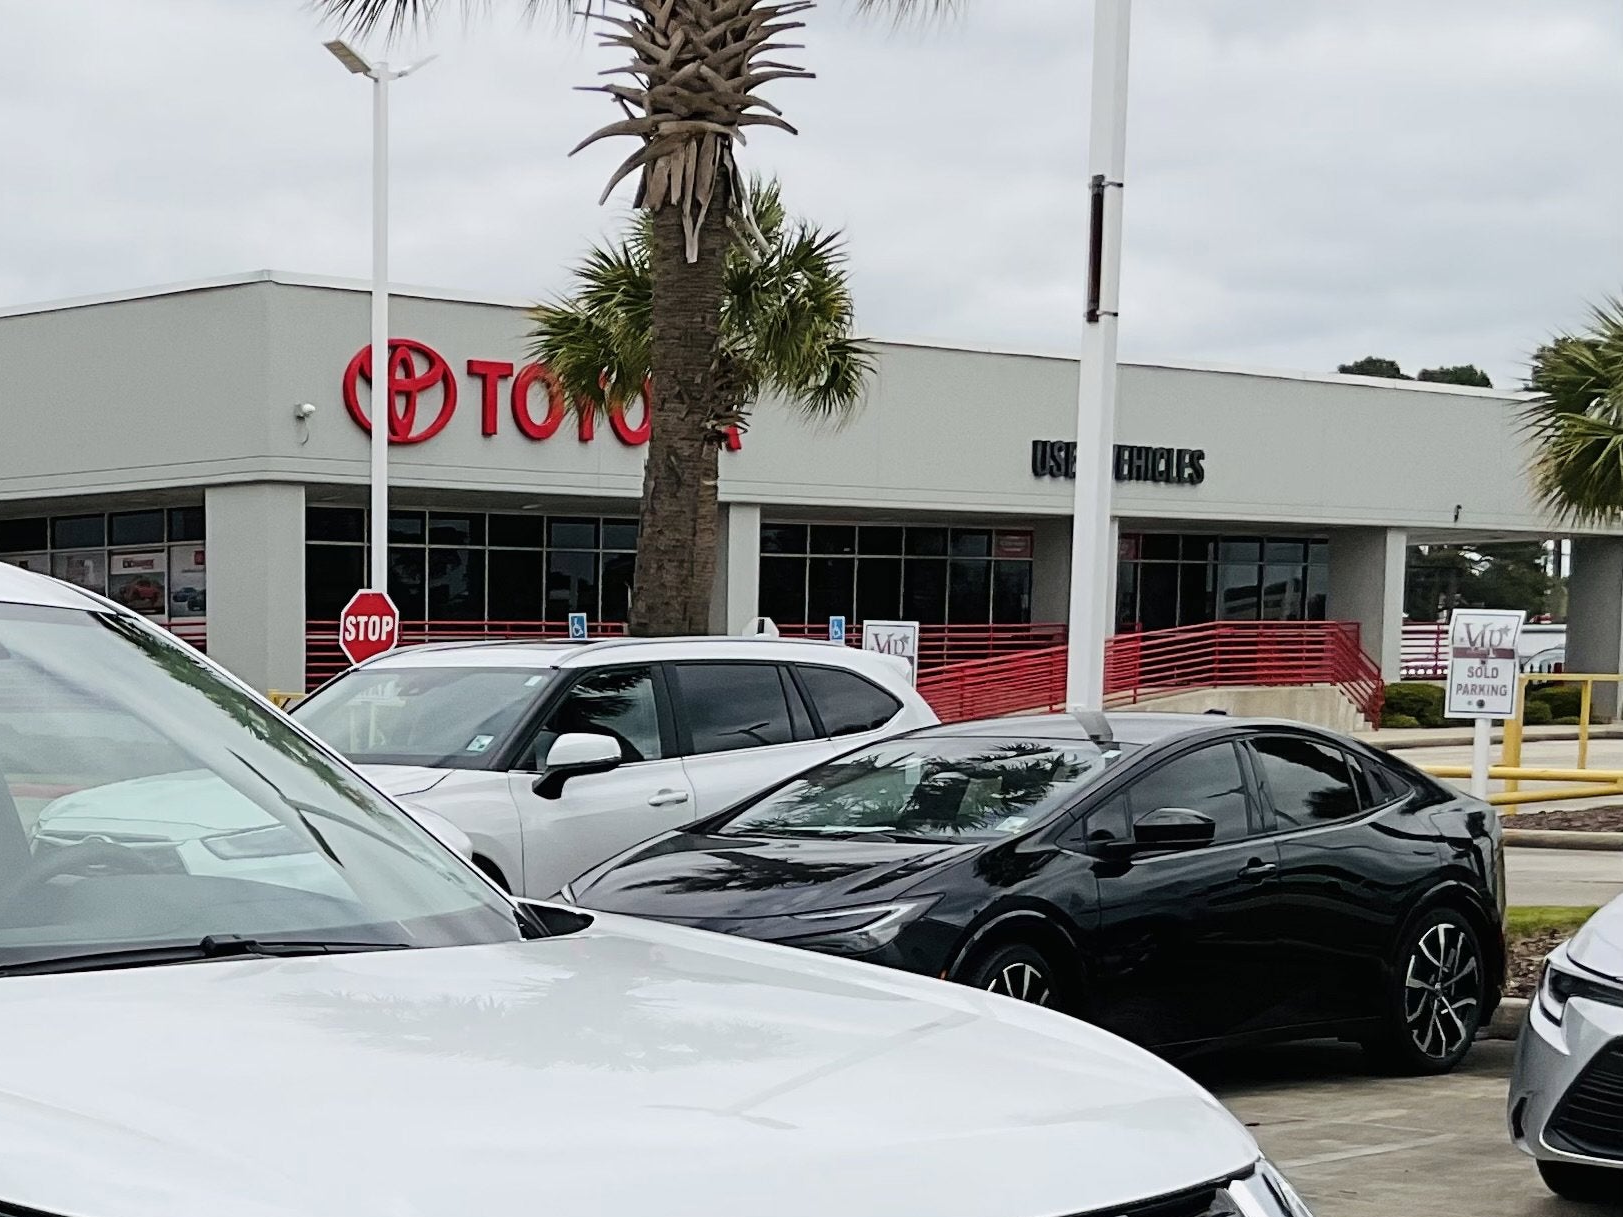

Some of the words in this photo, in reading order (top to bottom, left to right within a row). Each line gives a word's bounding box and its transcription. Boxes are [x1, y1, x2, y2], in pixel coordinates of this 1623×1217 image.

[467, 359, 742, 450] TOO
[1032, 439, 1077, 479] USE
[344, 615, 394, 642] STOP
[1467, 666, 1499, 679] SOLD
[1456, 683, 1508, 697] PARKING
